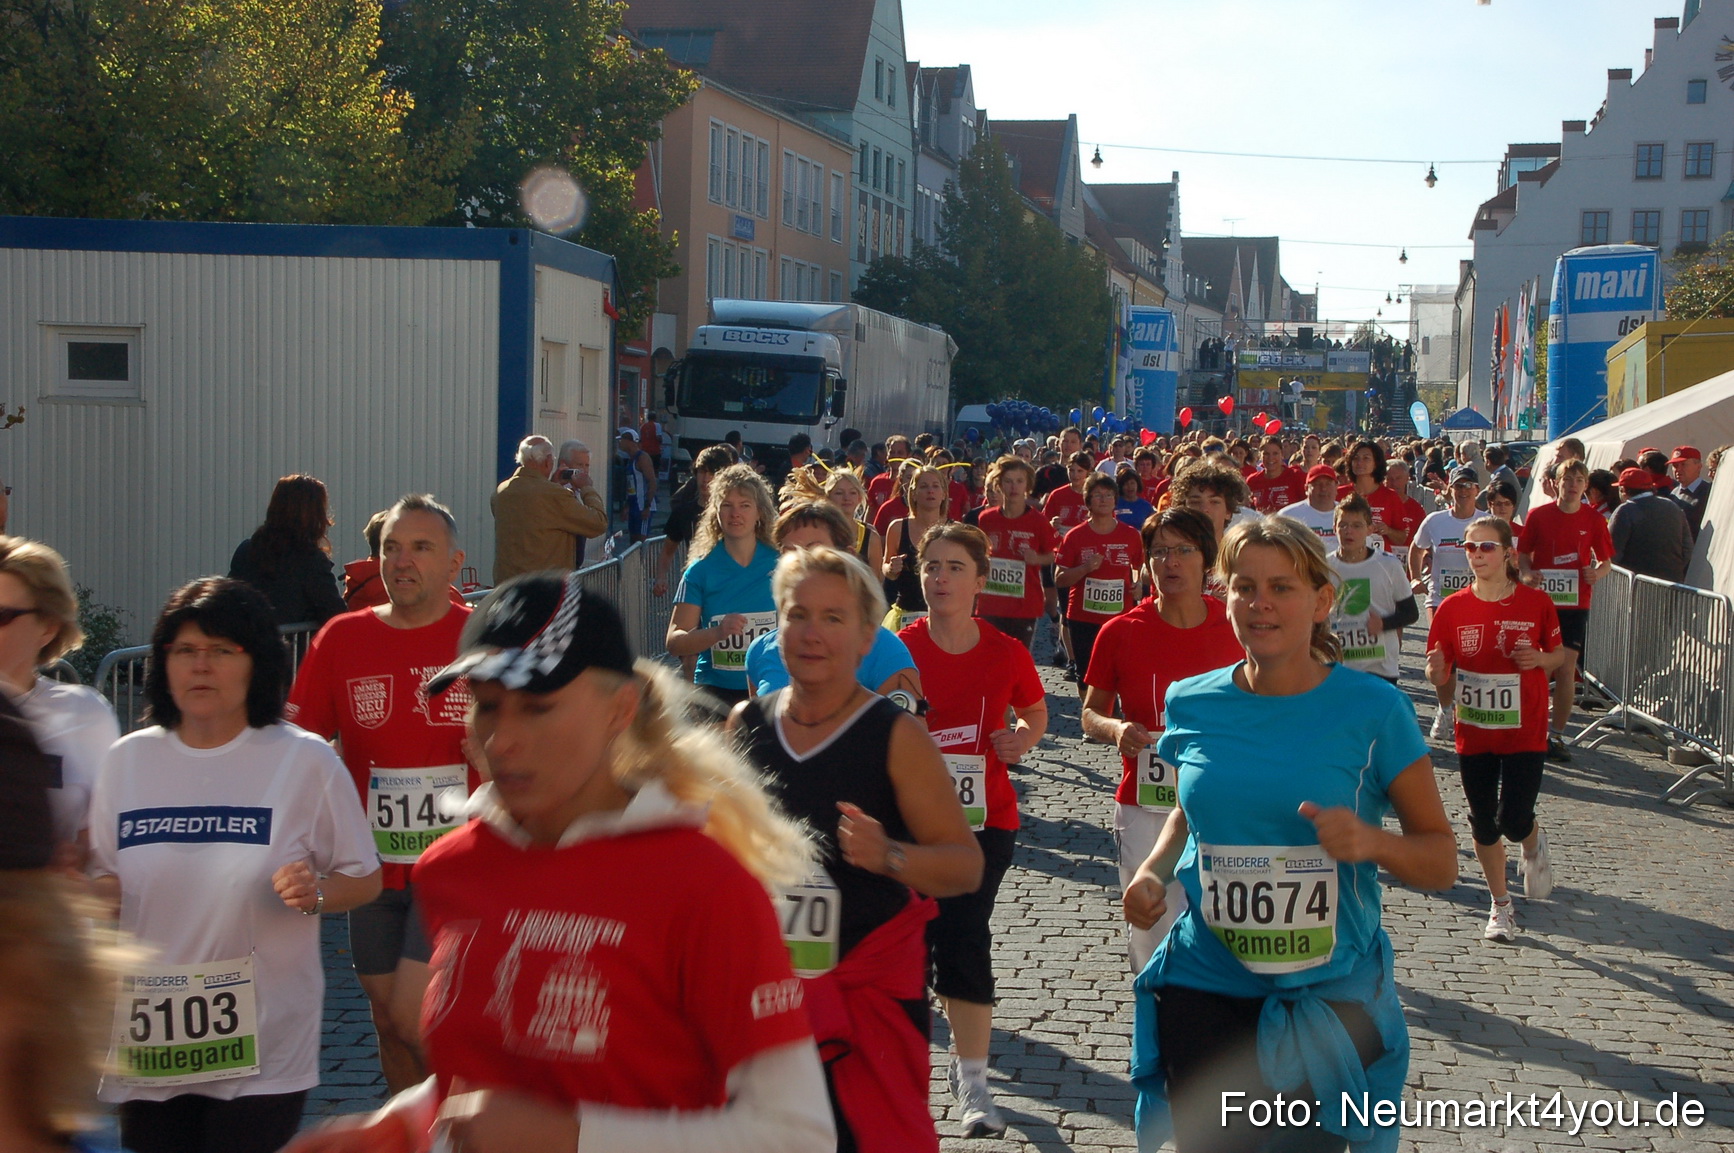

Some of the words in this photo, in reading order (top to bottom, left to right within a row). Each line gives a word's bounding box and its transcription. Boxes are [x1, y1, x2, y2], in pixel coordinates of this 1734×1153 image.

[1575, 263, 1648, 300] maxi
[723, 330, 790, 345] BOCK
[1142, 353, 1161, 367] dsl
[1282, 375, 1323, 385] ART
[1086, 587, 1122, 602] 10686
[719, 626, 771, 650] 01
[354, 682, 386, 692] IMMER
[1461, 685, 1512, 709] 5110
[356, 700, 384, 712] NEU
[1468, 708, 1505, 722] Sophia
[940, 731, 964, 742] DEHN
[1148, 753, 1165, 783] 5
[1156, 786, 1176, 802] Ge
[134, 817, 258, 837] STAEDTLER
[1213, 856, 1270, 868] PFLEIDERER
[1285, 859, 1323, 869] BOCK
[1208, 880, 1330, 924] 10674
[1224, 929, 1311, 956] Pamela
[136, 975, 188, 988] PFLEIDERER
[204, 972, 241, 985] BOCK
[129, 991, 240, 1043] 5103
[127, 1037, 245, 1071] Hildegard
